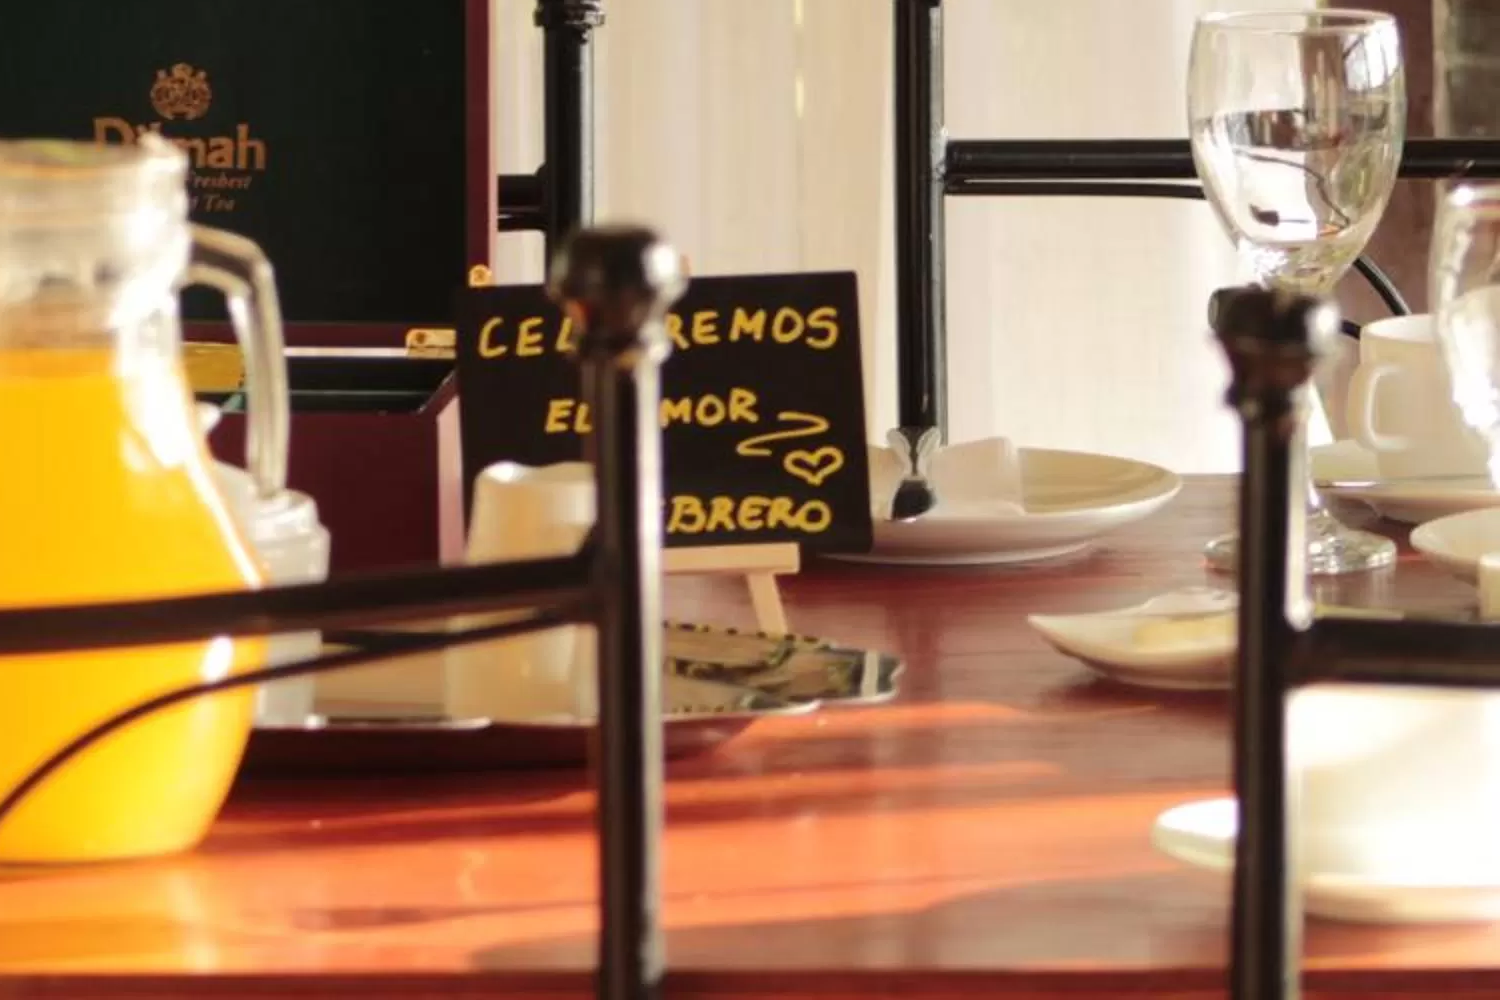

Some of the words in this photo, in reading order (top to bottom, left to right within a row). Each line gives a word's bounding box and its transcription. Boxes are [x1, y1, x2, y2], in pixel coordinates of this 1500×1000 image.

[478, 306, 840, 358] CELREMOS
[544, 398, 593, 434] EL
[660, 386, 759, 429] MOR
[661, 495, 832, 534] BRERO
